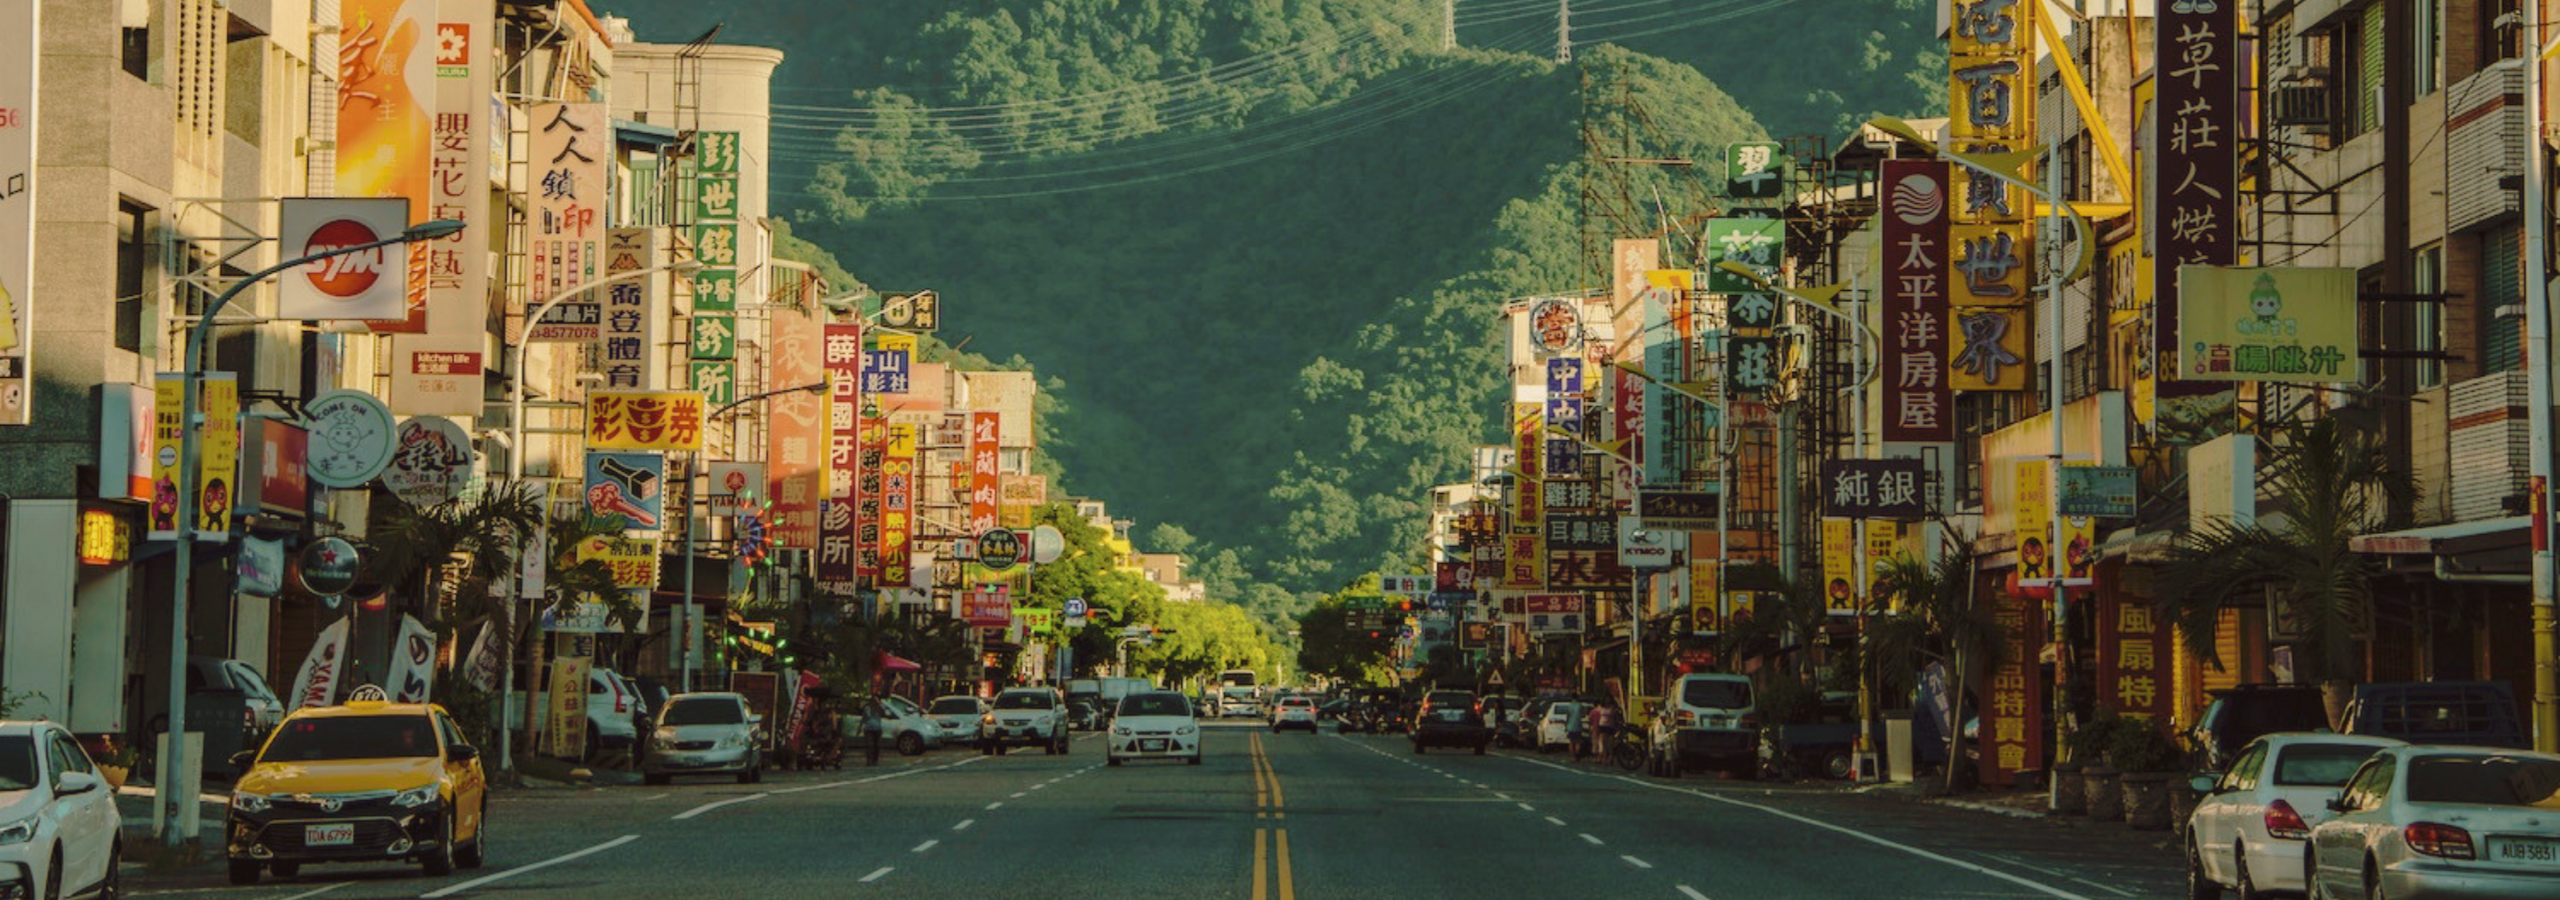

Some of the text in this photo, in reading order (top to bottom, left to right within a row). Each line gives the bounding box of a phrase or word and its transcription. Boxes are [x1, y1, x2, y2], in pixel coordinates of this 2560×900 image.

[2170, 22, 2222, 268] 草莊人烘
[541, 105, 594, 237] 人人鎖印
[303, 243, 383, 282] SYM
[1897, 233, 1939, 428] 太平洋房屋
[2235, 344, 2345, 375] 楊桃汁
[861, 373, 908, 392] 影社
[315, 402, 368, 421] COME ON
[1545, 483, 1592, 507] 雞排
[1834, 470, 1916, 507] 純銀
[1512, 539, 1536, 581] 湯包
[1625, 547, 1665, 556] KYMCO
[2117, 603, 2156, 720] 風扇特
